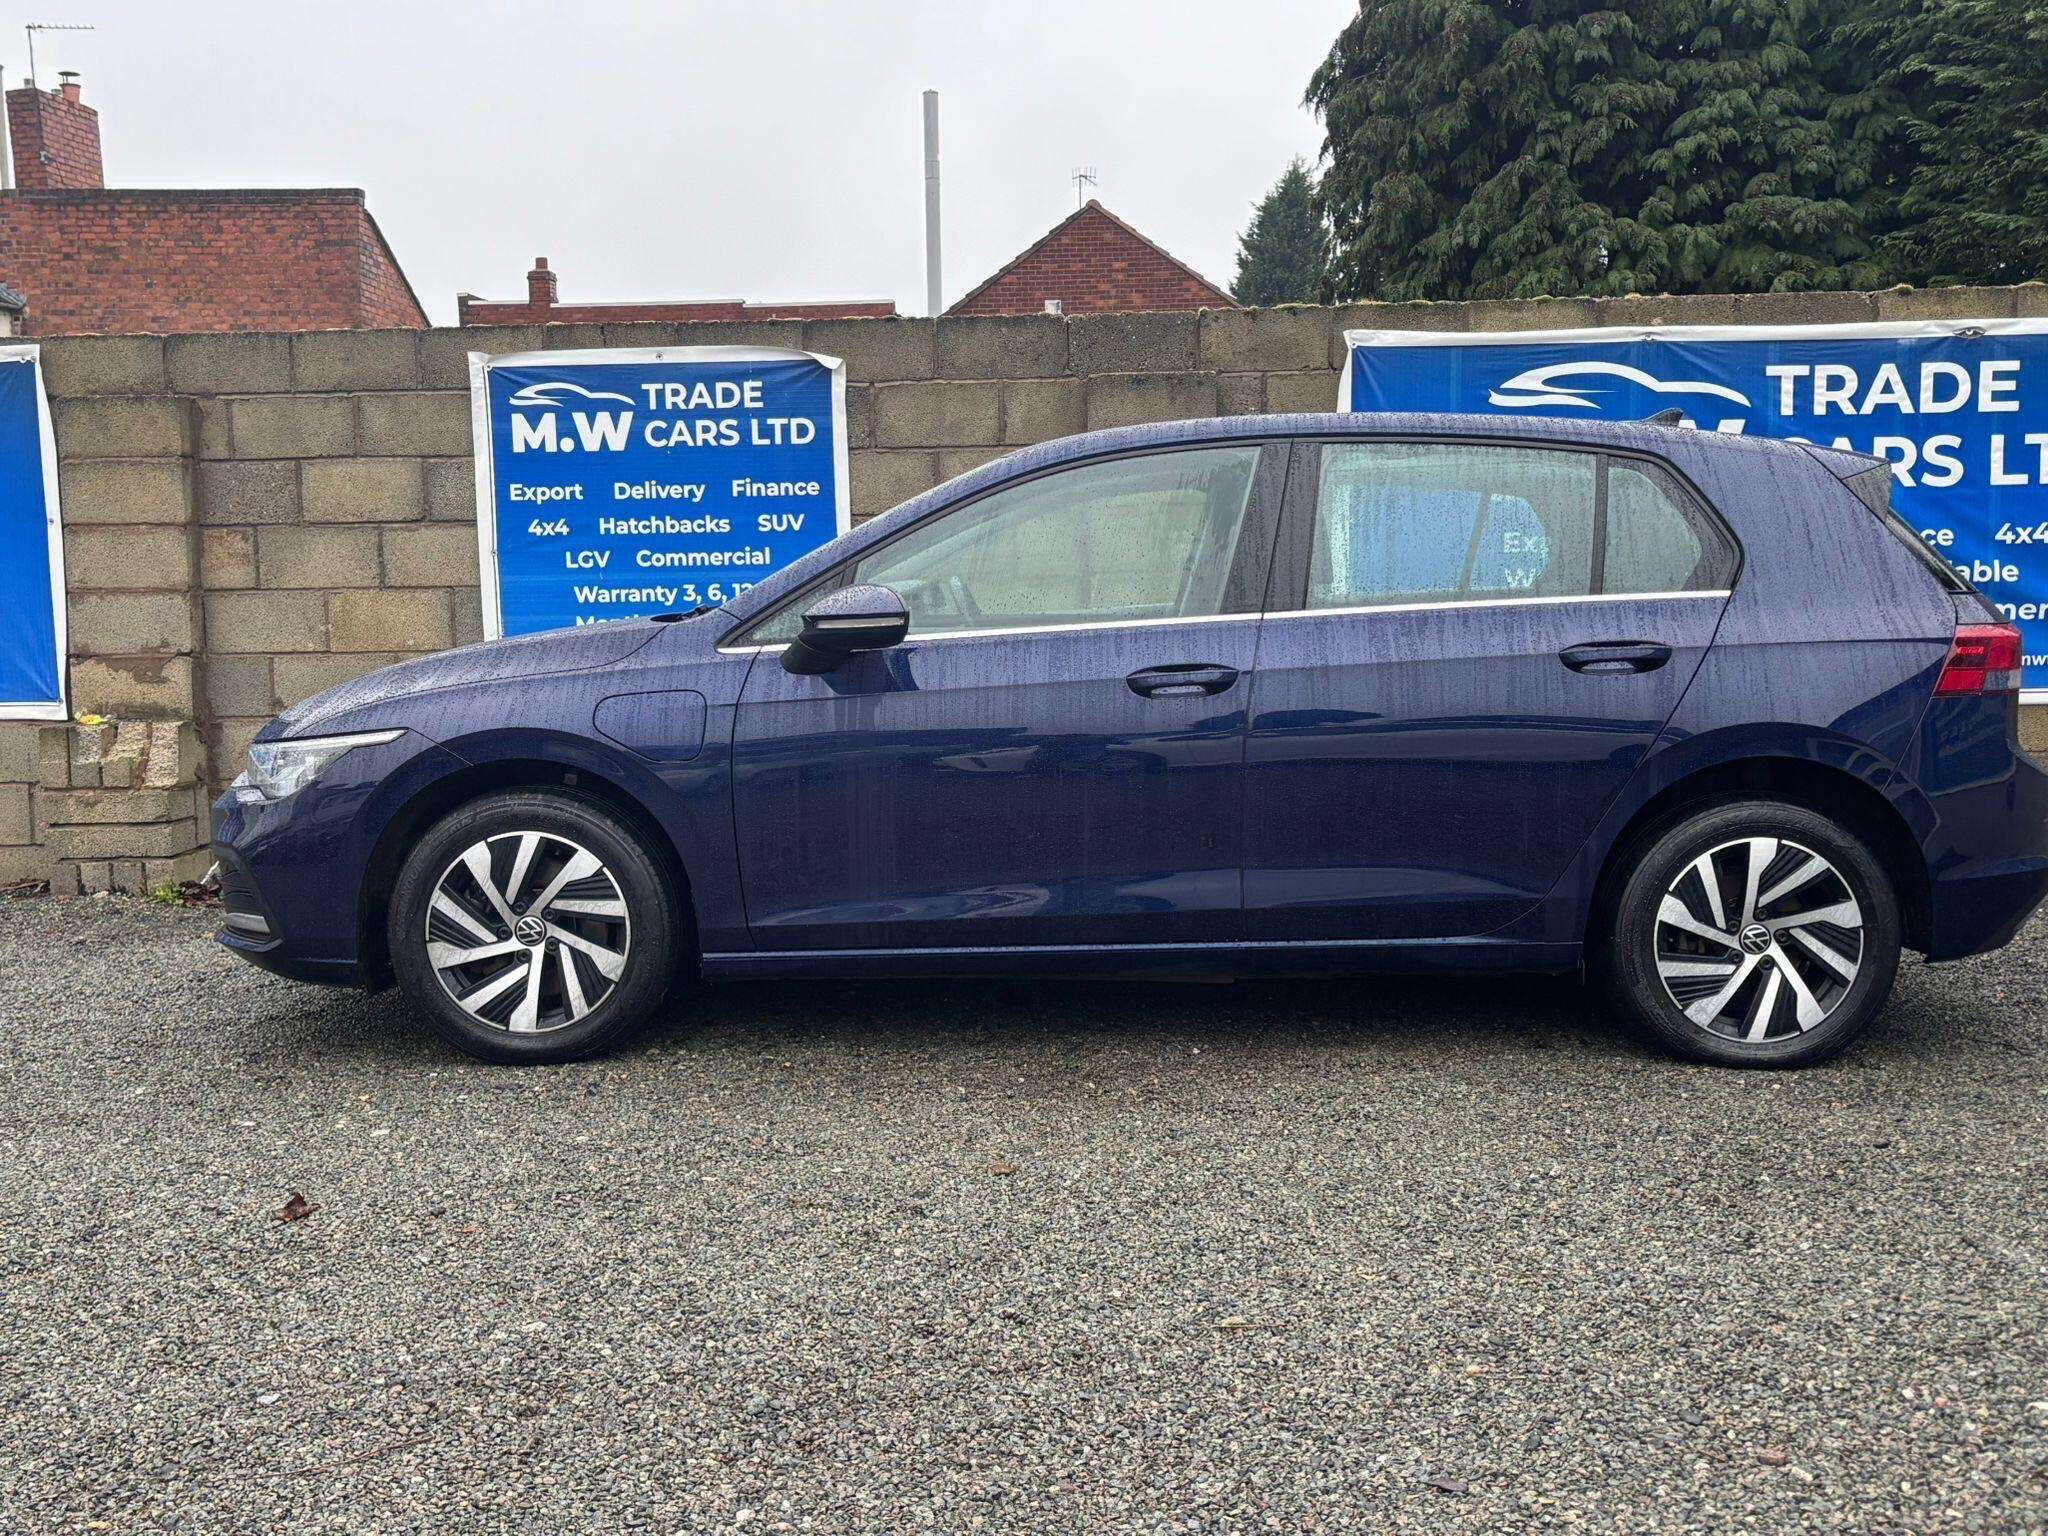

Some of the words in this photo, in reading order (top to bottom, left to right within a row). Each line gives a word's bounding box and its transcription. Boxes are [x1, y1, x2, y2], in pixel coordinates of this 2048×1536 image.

[641, 379, 764, 410] TRADE
[1765, 360, 2021, 416] TRADE
[511, 411, 634, 453] M.W
[644, 418, 739, 448] CARS
[750, 417, 816, 445] LTD
[1989, 433, 2048, 486] LT
[509, 484, 584, 504] Export
[614, 480, 706, 502] Delivery
[732, 478, 820, 497] Finance
[528, 519, 570, 536] 4x4
[599, 515, 731, 535] Hatchbacks
[758, 513, 805, 532] SUV
[565, 551, 611, 569] LGV
[636, 546, 771, 568] Commercial
[573, 586, 678, 606] Warranty
[683, 584, 701, 604] 3,
[707, 584, 728, 604] 6,
